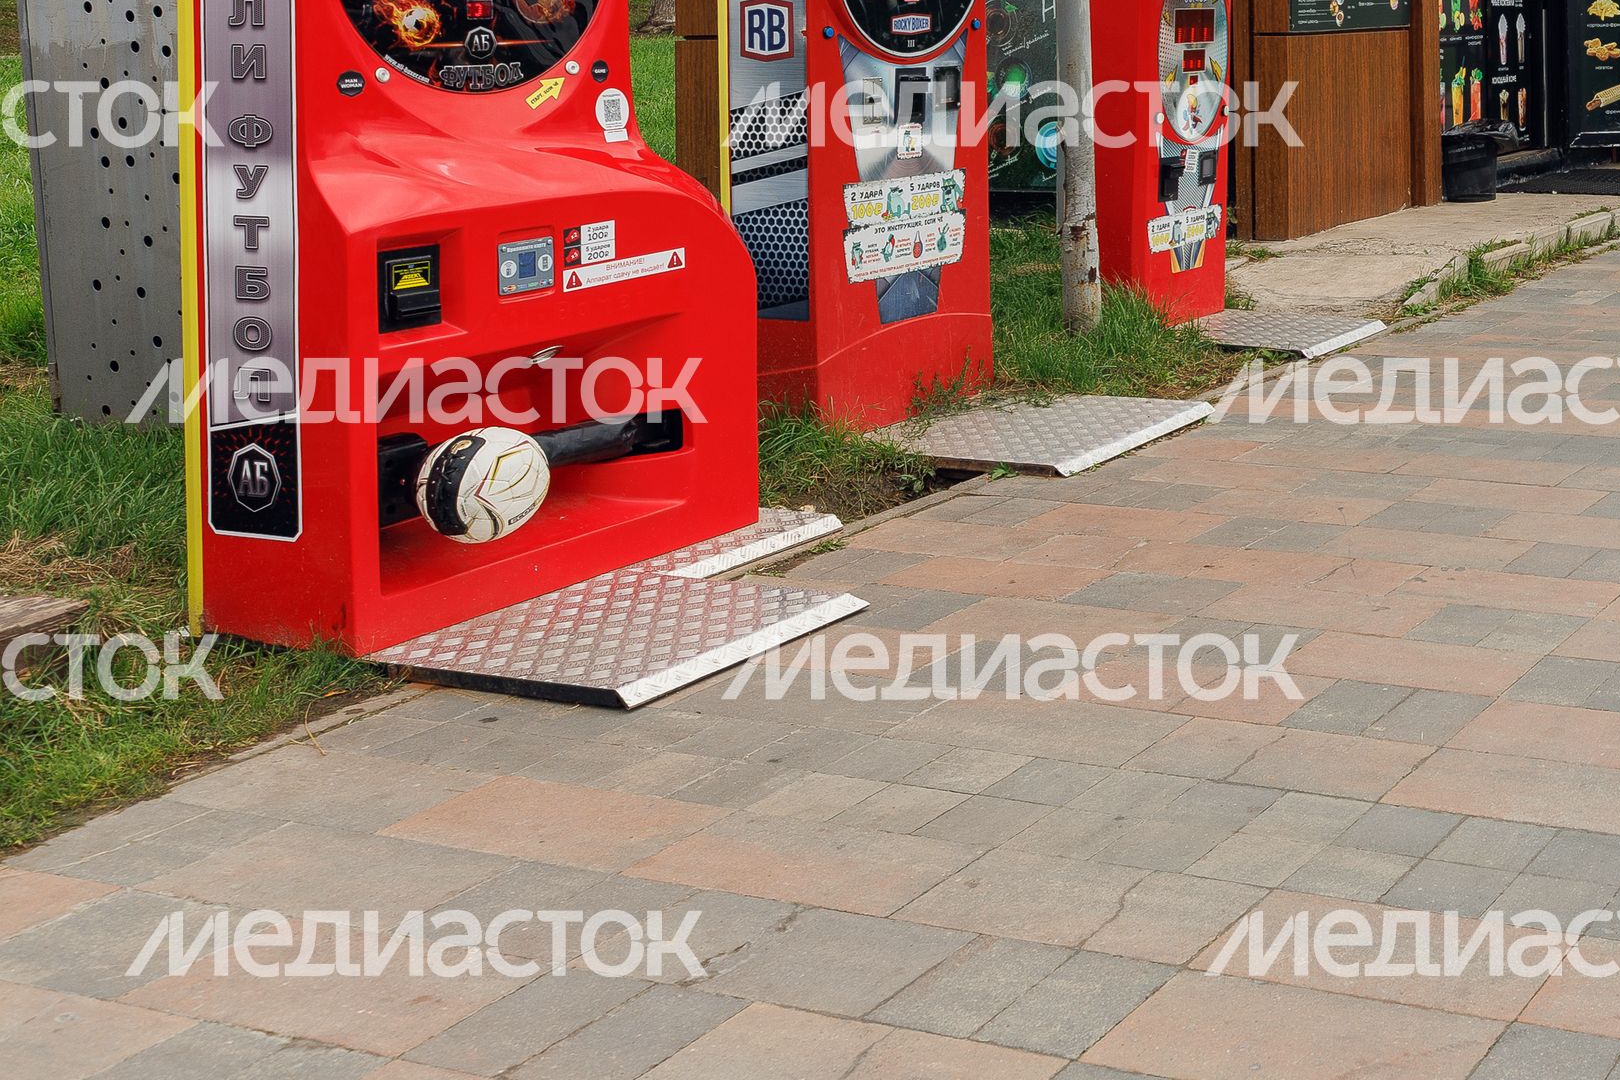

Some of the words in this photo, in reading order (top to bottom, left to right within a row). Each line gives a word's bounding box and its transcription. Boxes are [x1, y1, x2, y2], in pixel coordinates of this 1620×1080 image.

[748, 8, 786, 52] RB
[892, 16, 911, 32] ROCKY
[911, 16, 930, 32] BOXER
[472, 34, 490, 53] АБ
[439, 62, 524, 89] ФУТБОЛ
[340, 82, 363, 90] WOMAN
[910, 183, 915, 191] 5
[917, 181, 940, 191] УДАРОВ
[851, 192, 856, 201] 2
[860, 189, 883, 199] УДАРА
[592, 223, 609, 233] удара
[874, 227, 885, 235] ЭТО
[924, 218, 937, 226] ЕСЛИ
[1156, 222, 1170, 230] УДАРА
[590, 243, 611, 253] ударов
[228, 114, 274, 403] ФУТБОЛ
[605, 258, 645, 271] ВНИМАНИЕ!
[585, 273, 612, 285] Аппарат
[613, 271, 631, 281] сдачу
[238, 459, 269, 498] АБ
